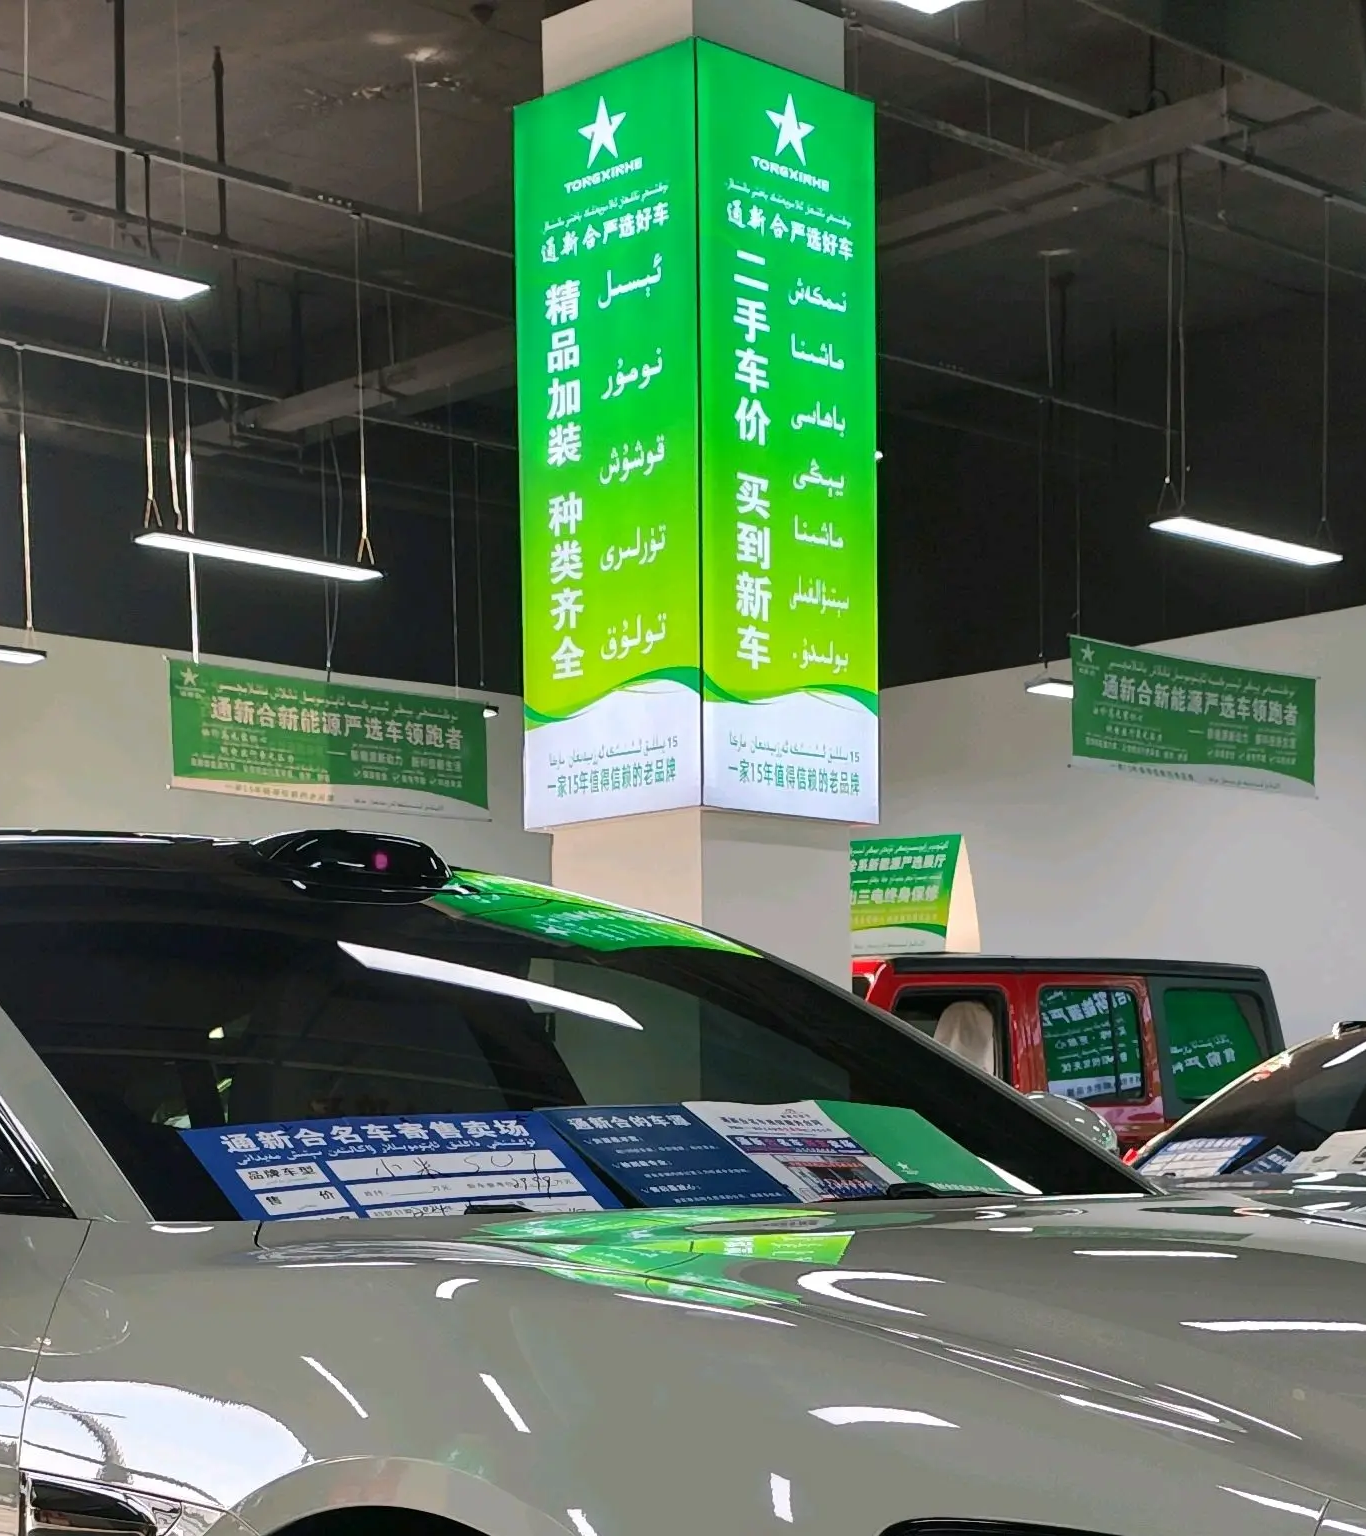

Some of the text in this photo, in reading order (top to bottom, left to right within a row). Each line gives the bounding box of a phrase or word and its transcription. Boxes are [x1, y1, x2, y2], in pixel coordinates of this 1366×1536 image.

[541, 202, 670, 264] 通新合严选好车
[726, 199, 854, 261] 通新合严选好车
[545, 280, 585, 681] 精品加装 种类齐全
[733, 249, 773, 671] 二手车价 买到新车
[210, 695, 464, 752] 通新合新能源严选车领跑者
[547, 757, 677, 799] 一家15年值得信赖的老品牌
[728, 759, 860, 797] 一家15年值得信赖的老品牌
[220, 1119, 532, 1154] 通新合名车寄售卖场
[248, 1165, 317, 1181] 品牌车型
